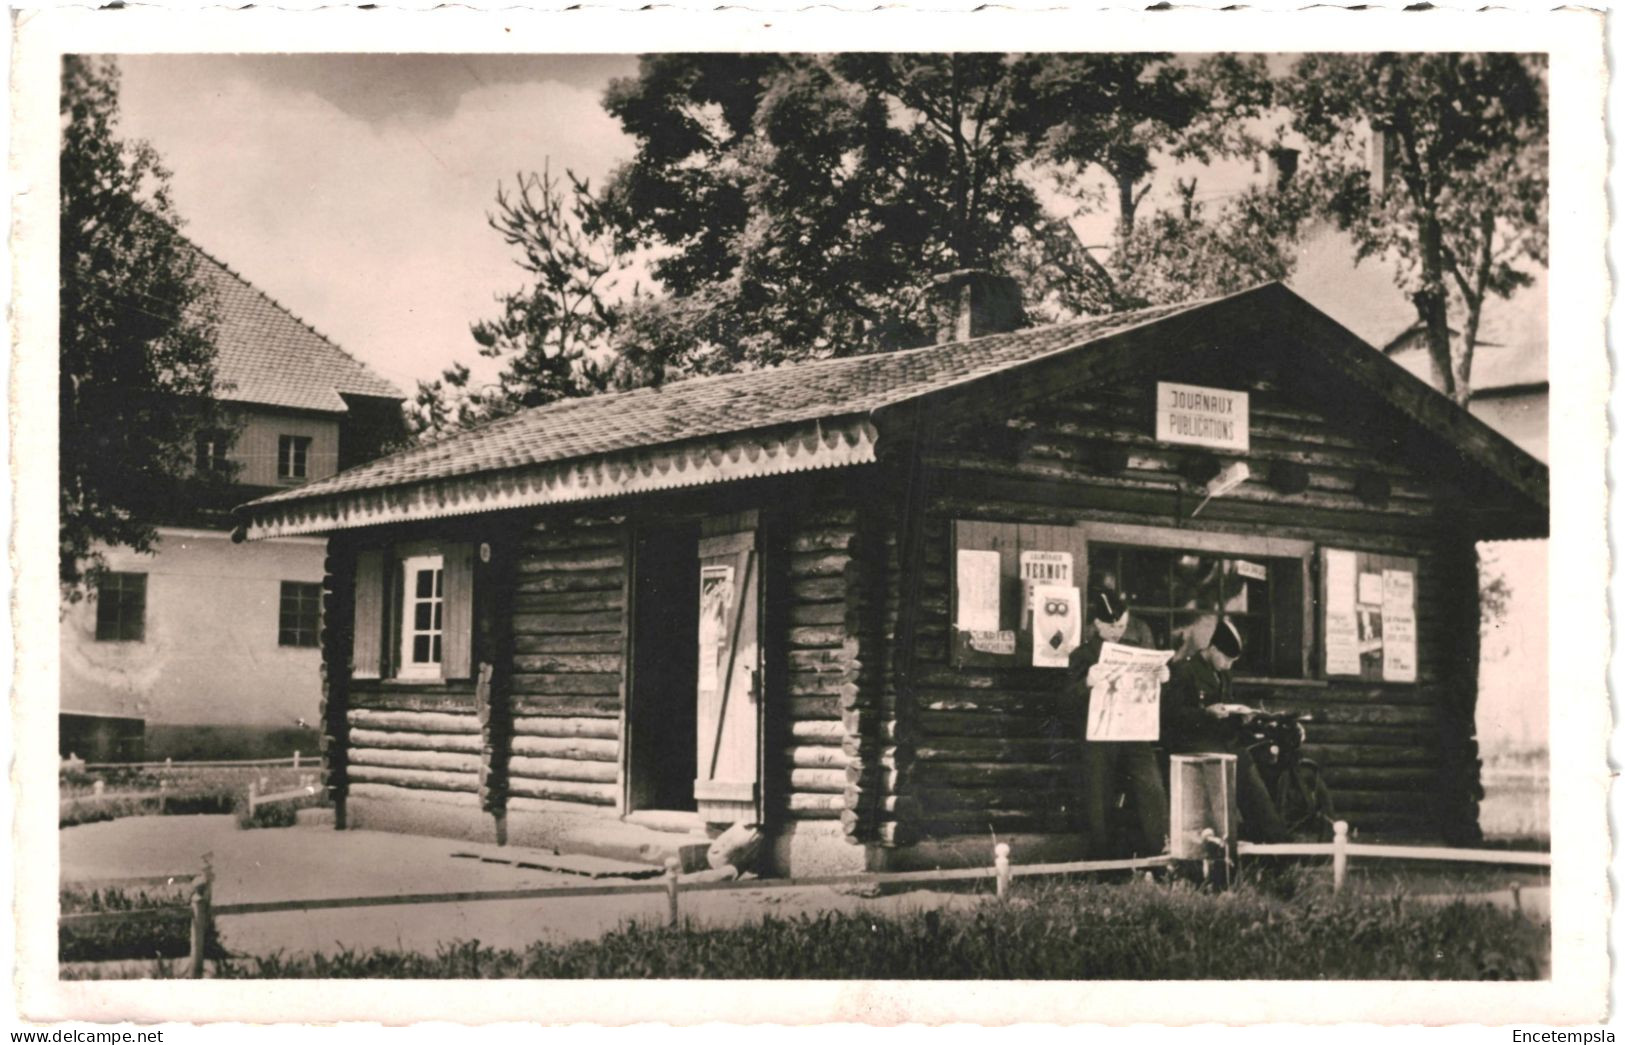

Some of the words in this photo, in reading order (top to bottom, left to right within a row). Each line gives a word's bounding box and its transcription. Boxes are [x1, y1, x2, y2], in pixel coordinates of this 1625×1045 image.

[1170, 390, 1233, 414] JOURNAUX
[1169, 414, 1234, 441] PUBLICATIONS
[1025, 562, 1068, 580] VERMOT
